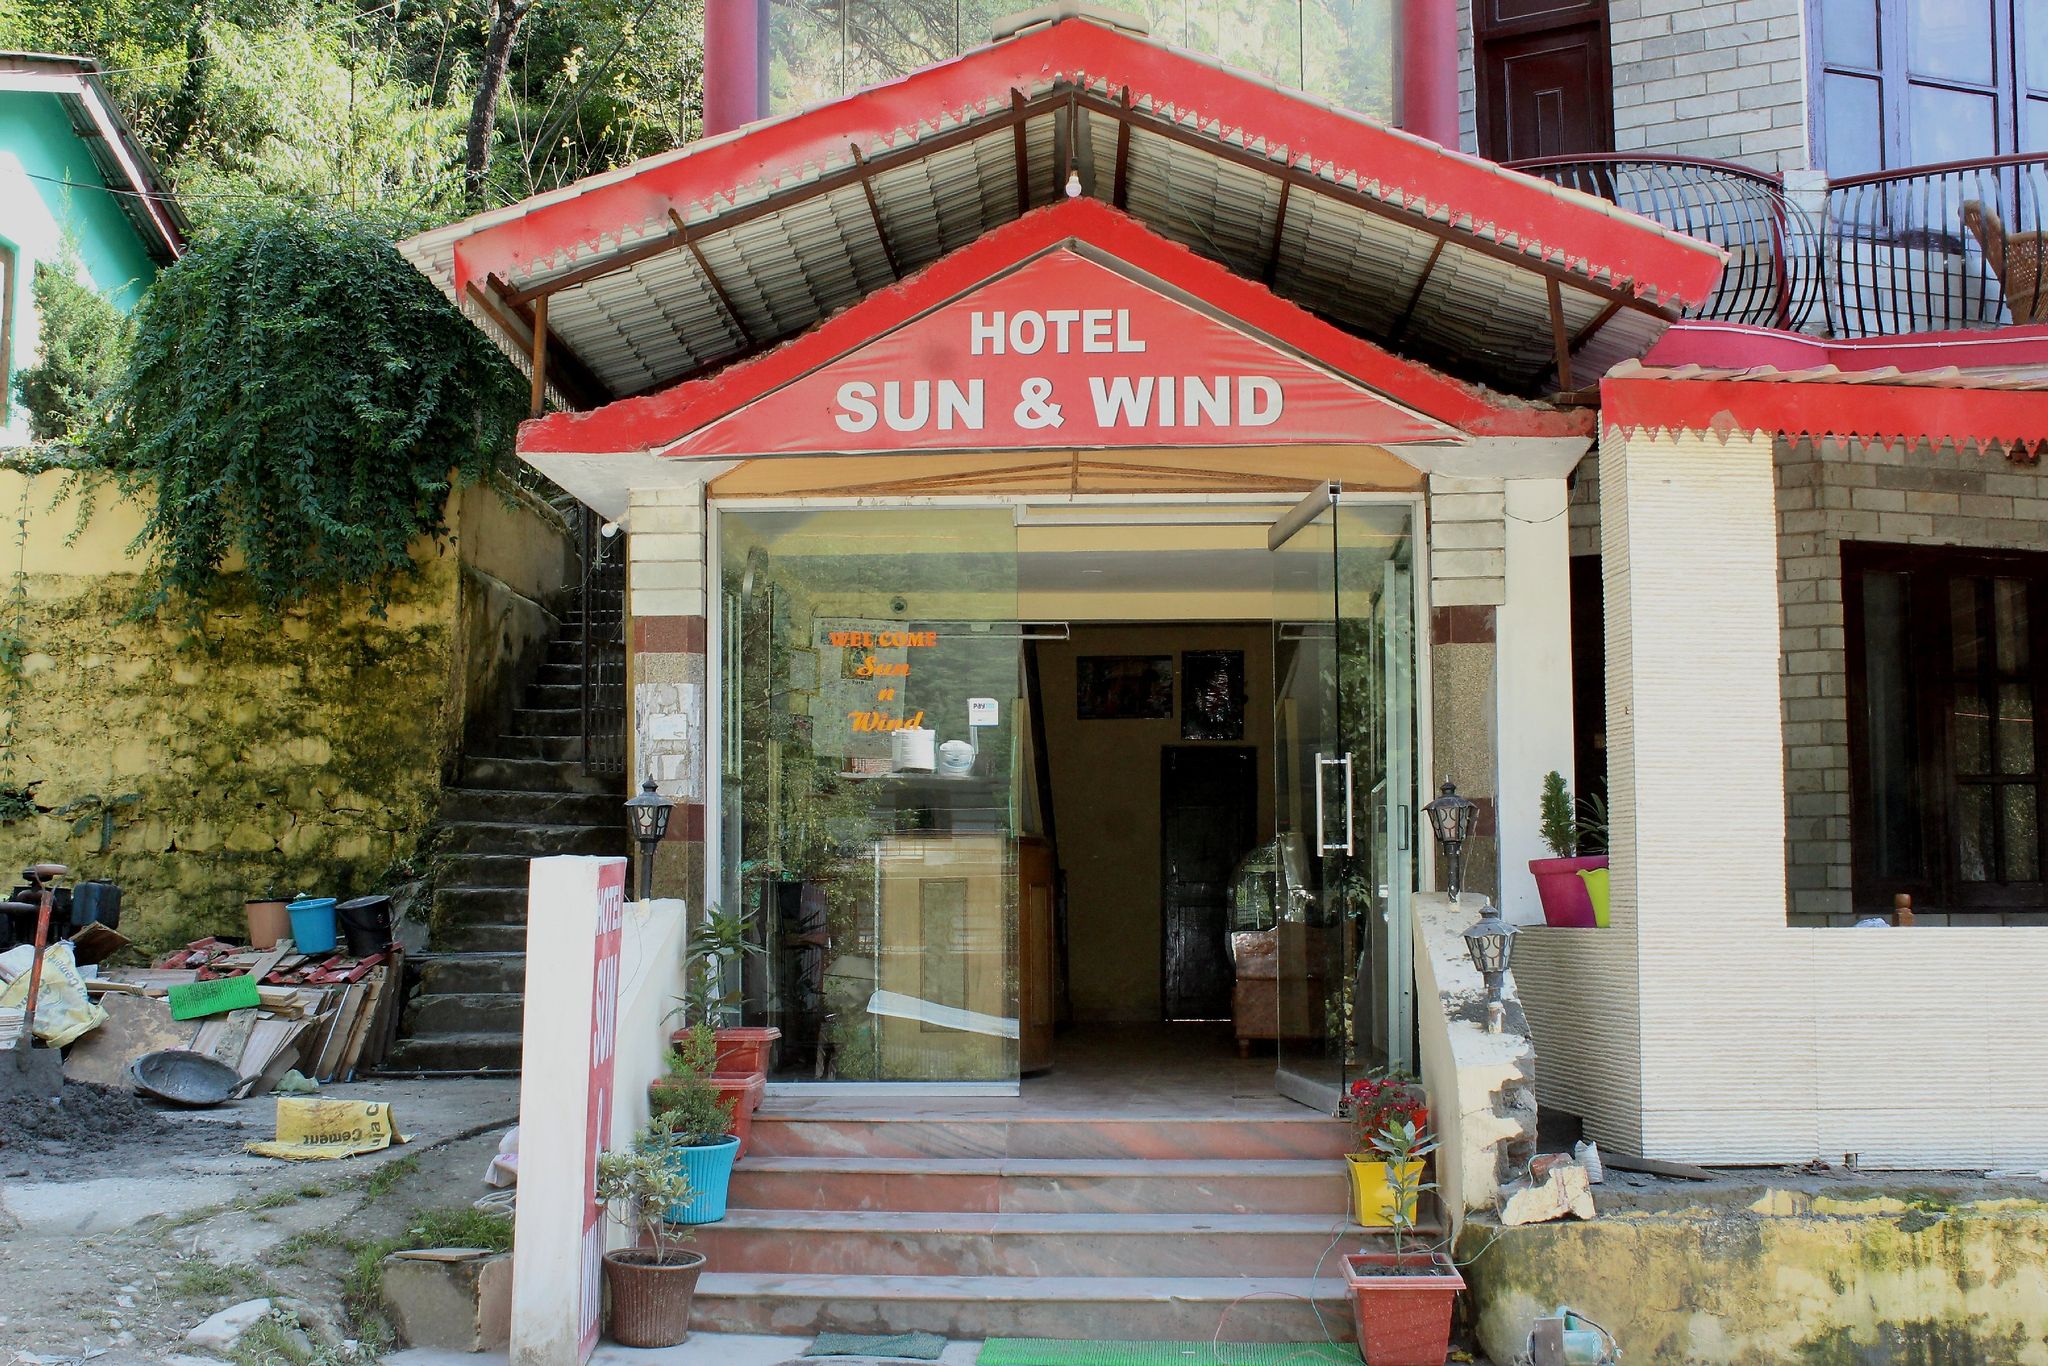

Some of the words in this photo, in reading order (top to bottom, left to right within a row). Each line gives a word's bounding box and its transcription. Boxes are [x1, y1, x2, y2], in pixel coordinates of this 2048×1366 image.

[970, 309, 1146, 355] HOTEL
[834, 379, 985, 433] SUN
[1013, 377, 1065, 430] &
[1089, 376, 1285, 428] WIND
[828, 631, 938, 648] WELCOME
[856, 655, 911, 677] Sun
[877, 687, 895, 702] n
[848, 710, 925, 733] Wind
[597, 885, 622, 936] HOTEL
[593, 953, 617, 1069] SUN
[303, 1128, 363, 1146] Cement
